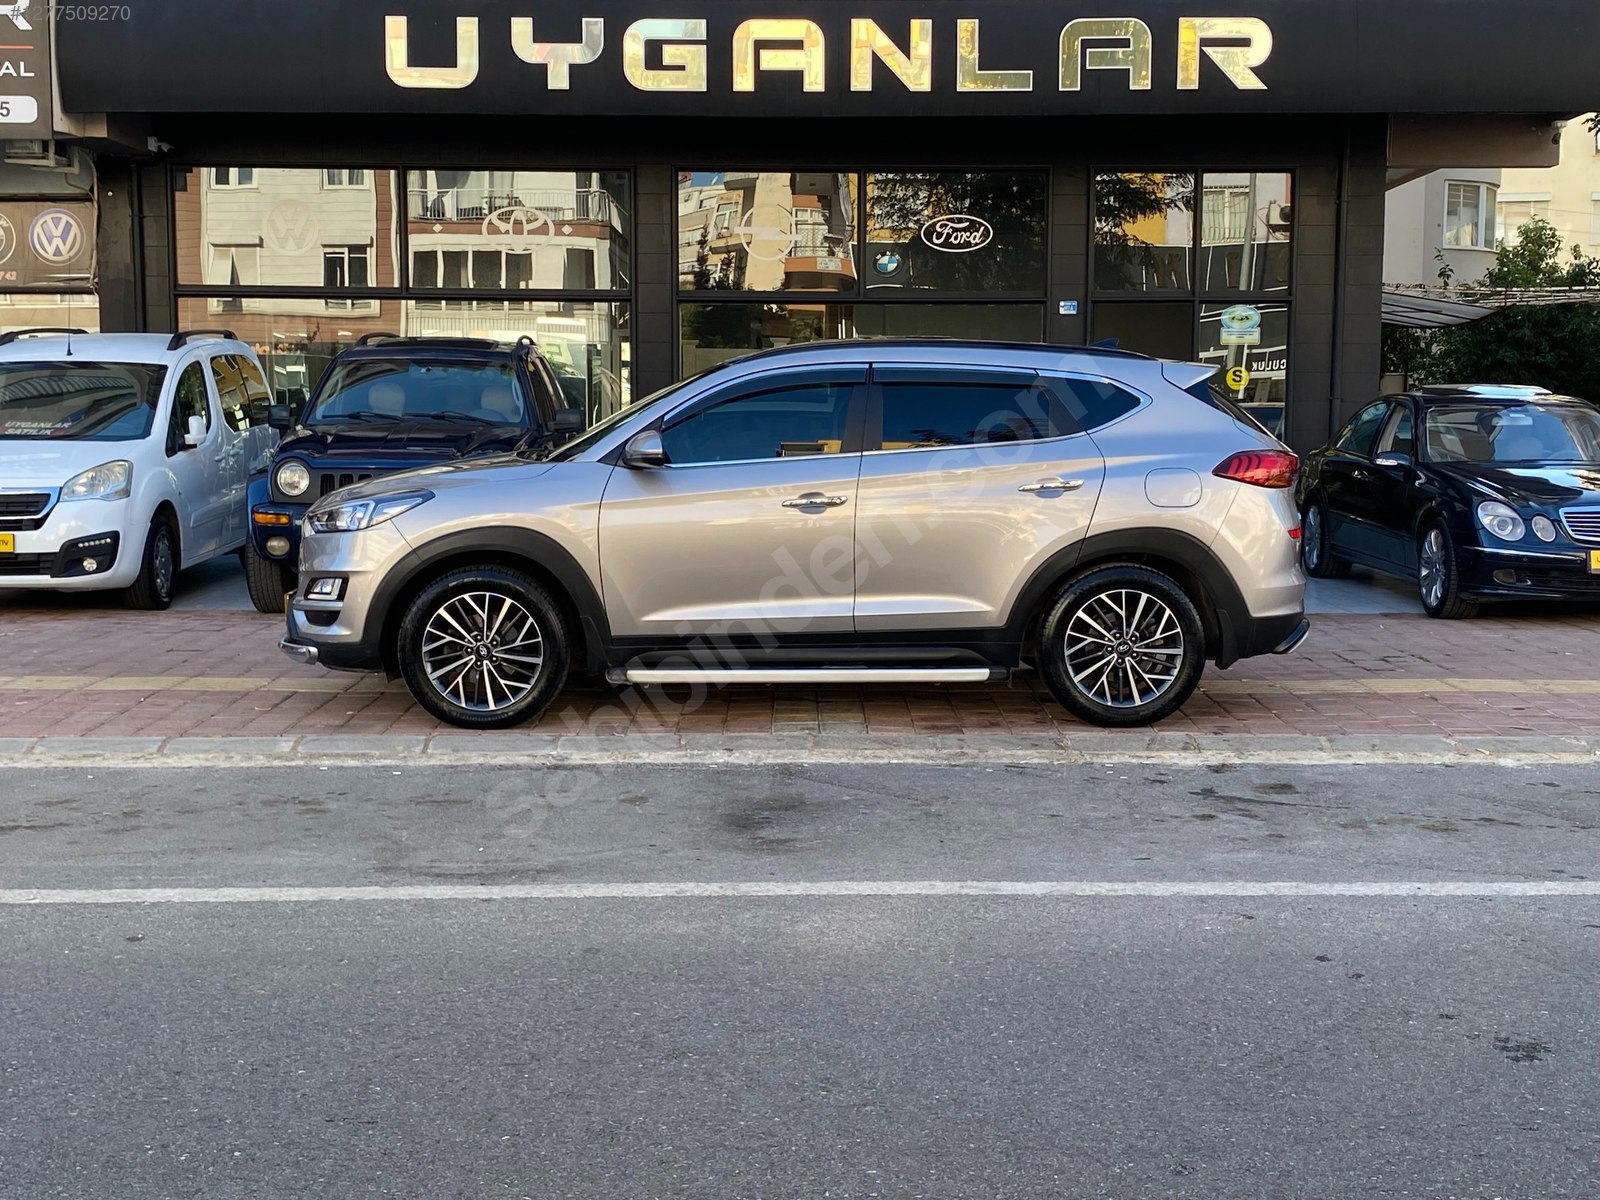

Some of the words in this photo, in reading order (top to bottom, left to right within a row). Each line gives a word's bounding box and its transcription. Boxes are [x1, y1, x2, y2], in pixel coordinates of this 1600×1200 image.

[384, 15, 1273, 92] UYGANLAR
[932, 221, 985, 244] Ford
[1232, 369, 1243, 383] S
